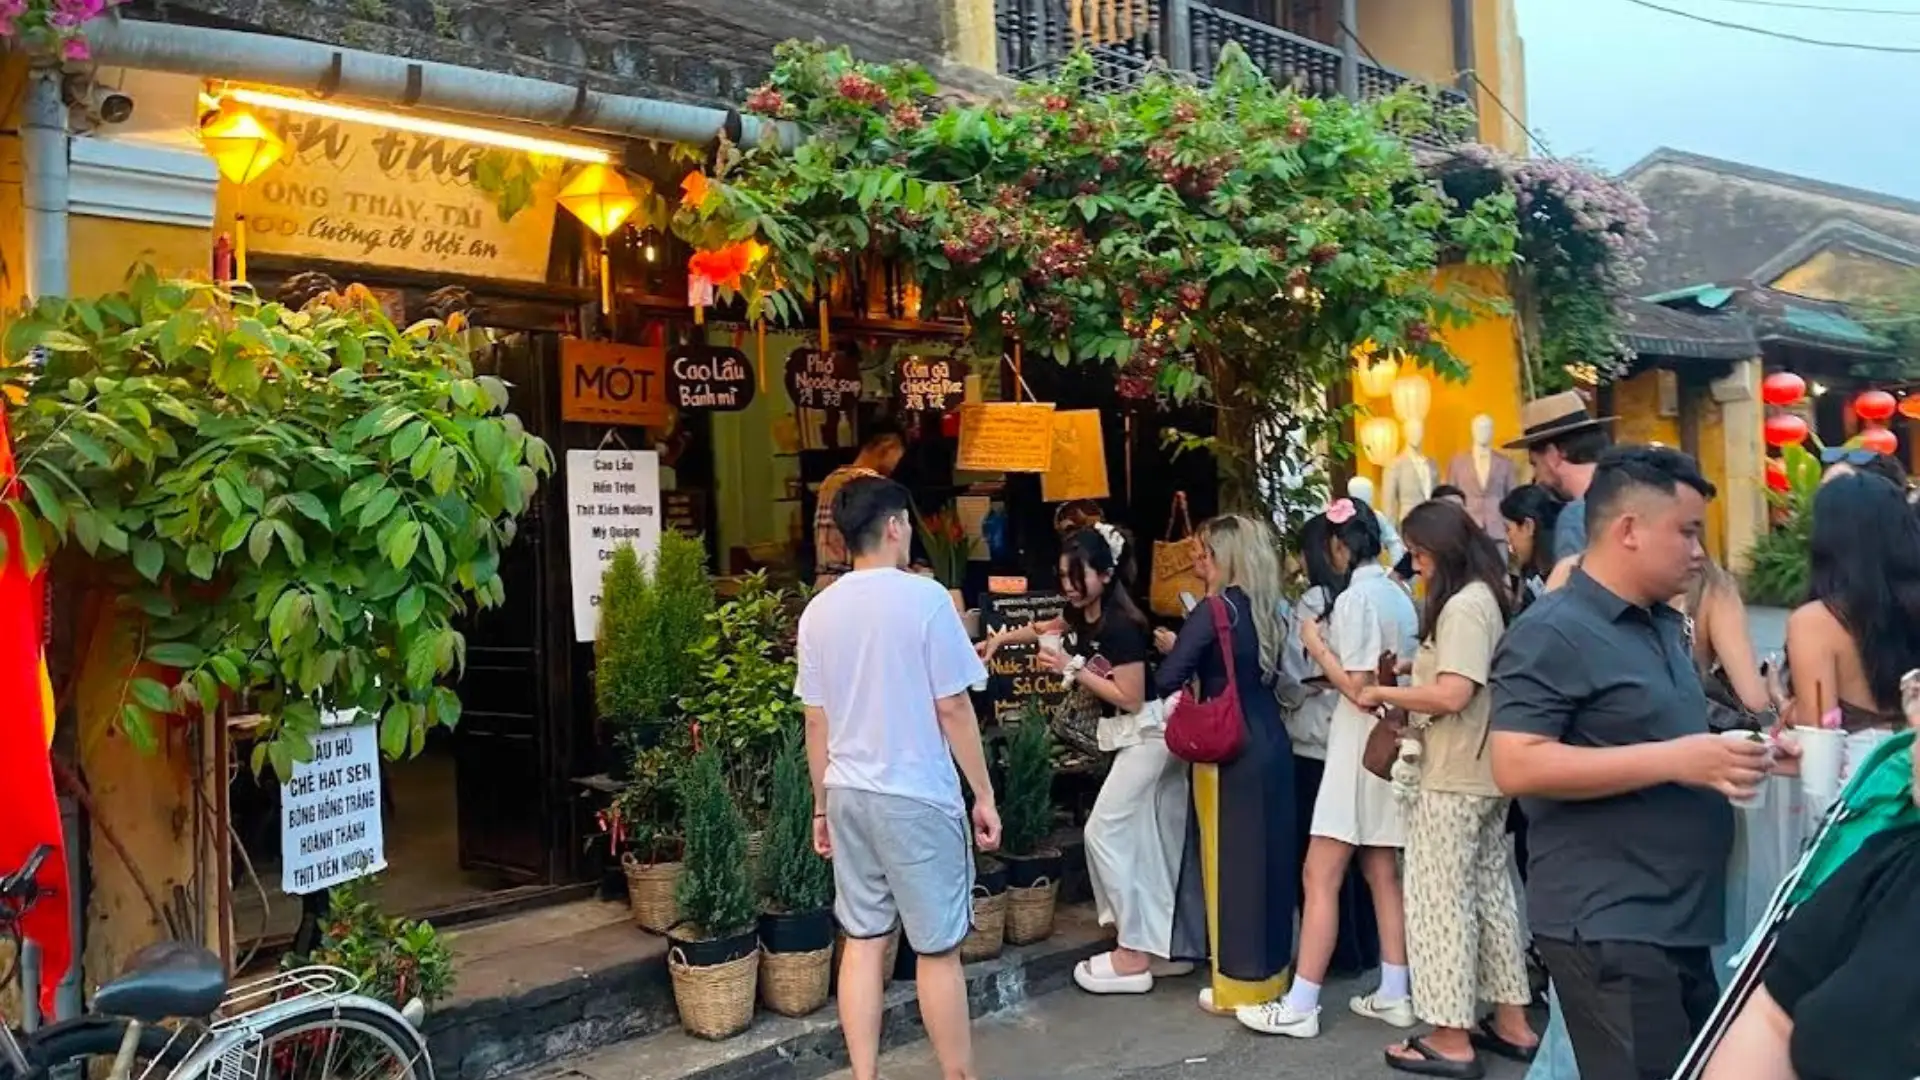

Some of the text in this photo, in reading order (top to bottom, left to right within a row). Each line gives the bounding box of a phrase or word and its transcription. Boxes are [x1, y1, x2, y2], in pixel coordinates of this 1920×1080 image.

[574, 357, 656, 403] MÓT
[673, 357, 711, 381] Cao
[678, 385, 716, 407] Bánh
[593, 458, 613, 471] Cao
[290, 763, 371, 797] CHÈ HẠT SEN
[294, 865, 314, 889] THỊT
